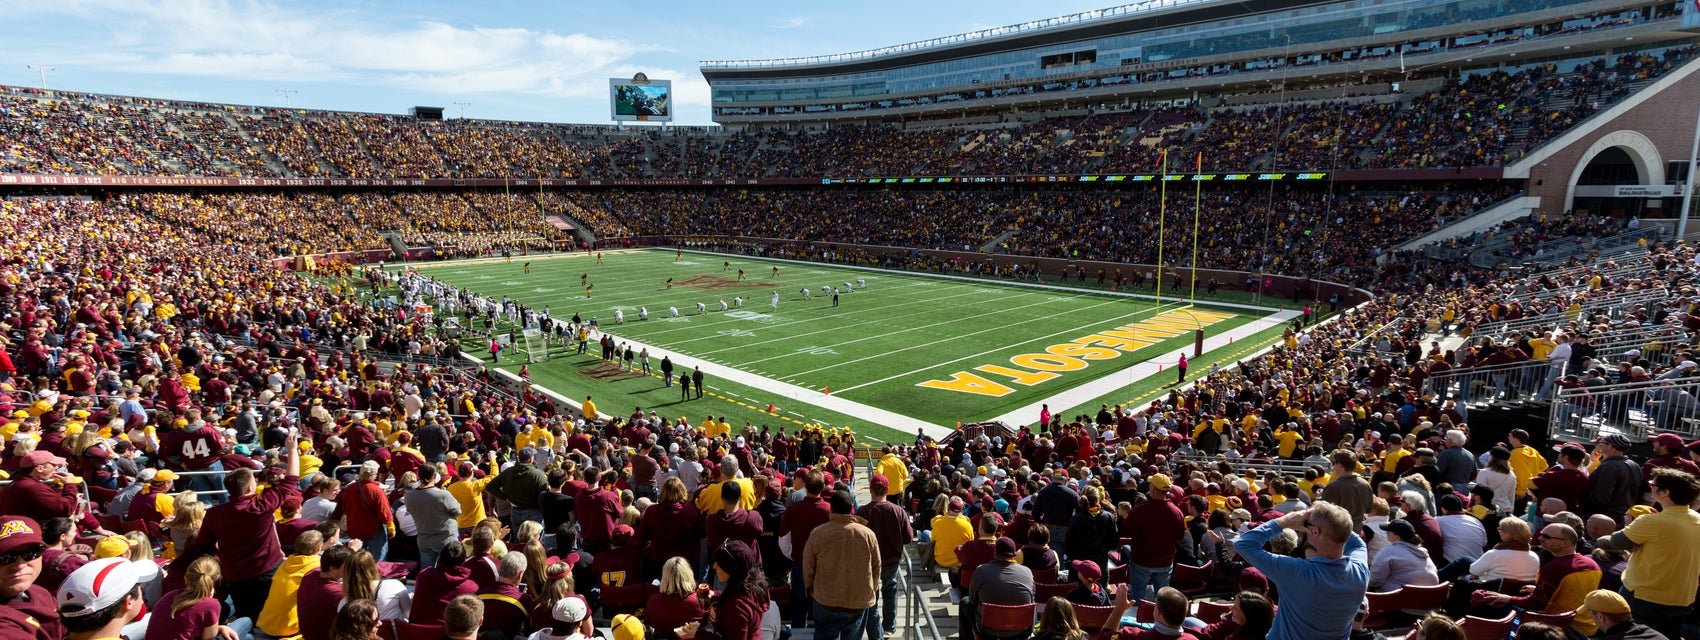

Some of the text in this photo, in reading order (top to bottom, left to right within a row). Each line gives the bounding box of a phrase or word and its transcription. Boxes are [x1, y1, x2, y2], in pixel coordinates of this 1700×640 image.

[41, 176, 57, 184] 1911
[111, 177, 229, 185] BIG TEN CHAMPIONSHIPS
[1258, 173, 1286, 181] SUBWAY
[914, 309, 1238, 397] MINNESOTA
[182, 437, 211, 459] 44
